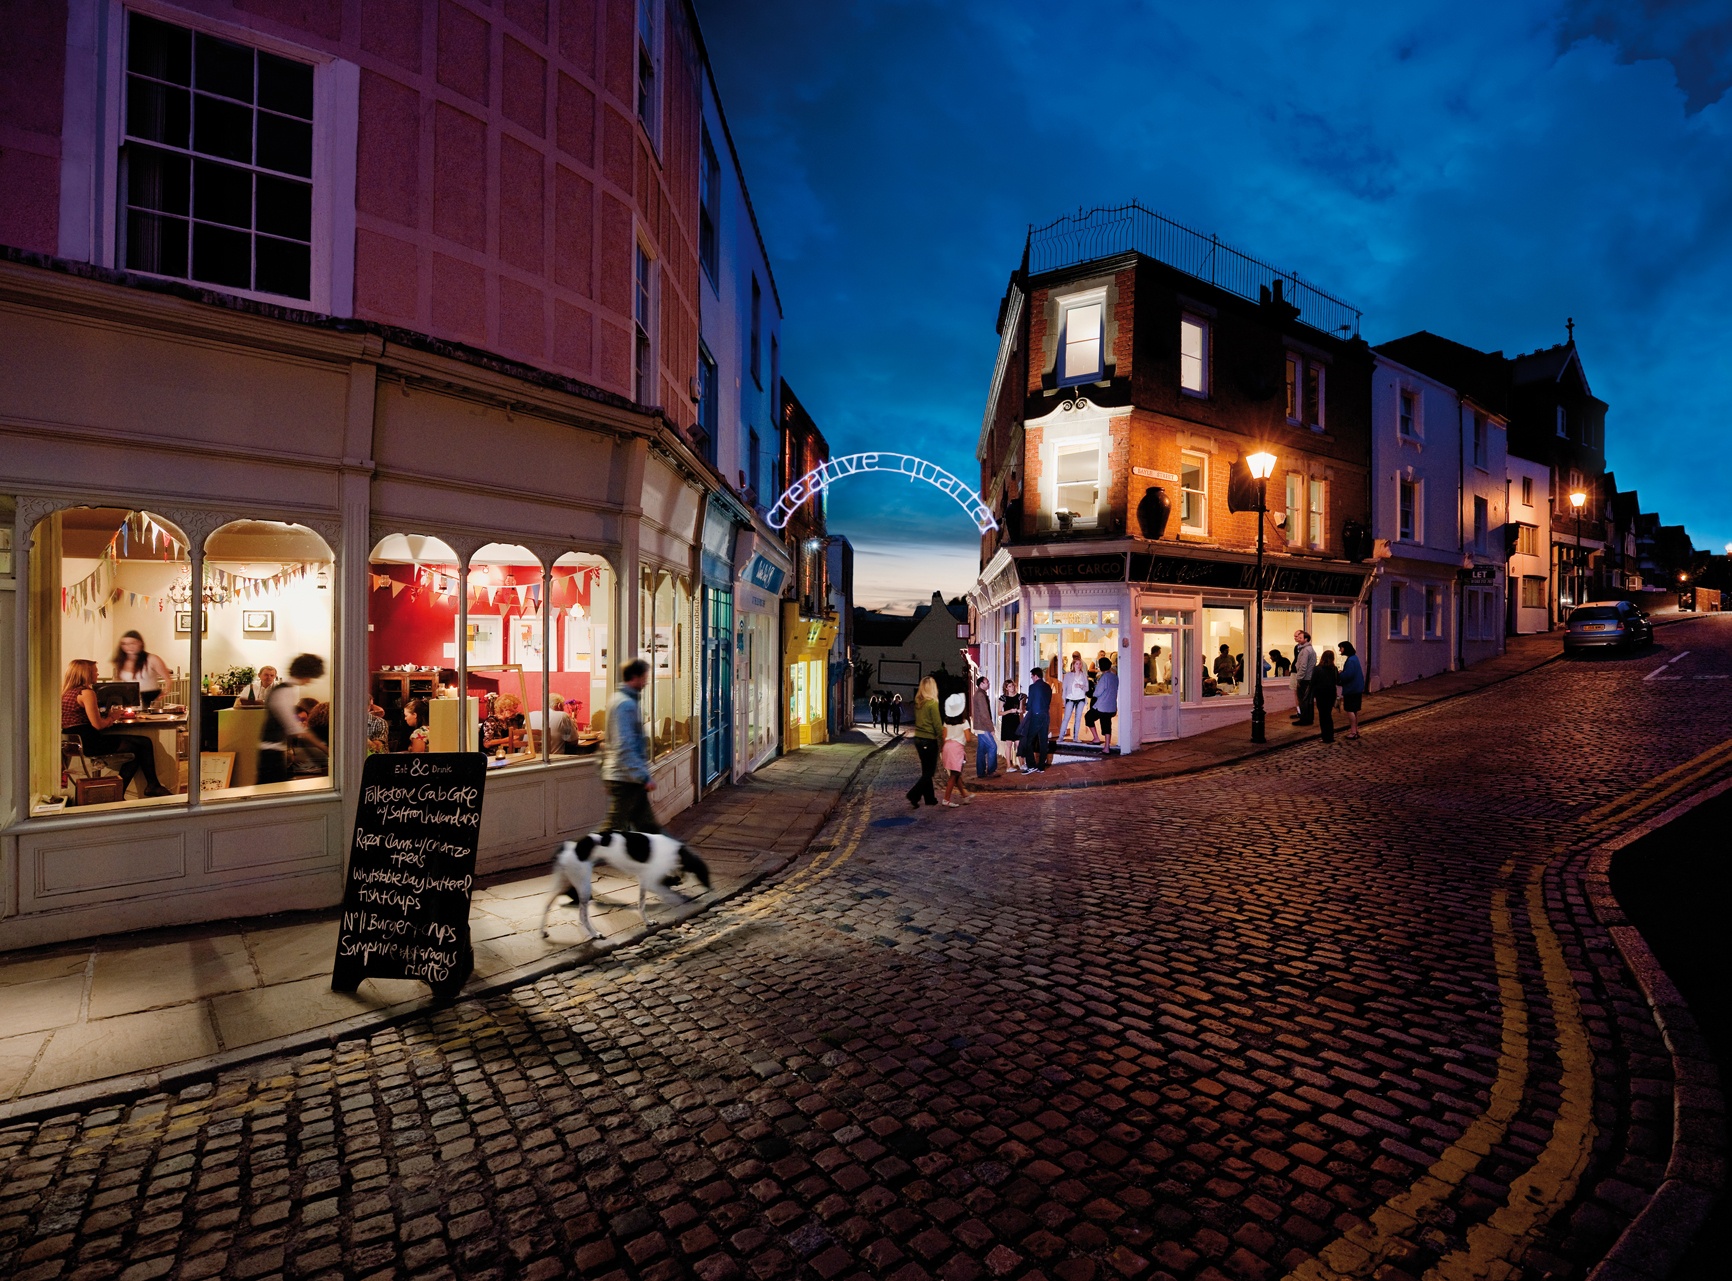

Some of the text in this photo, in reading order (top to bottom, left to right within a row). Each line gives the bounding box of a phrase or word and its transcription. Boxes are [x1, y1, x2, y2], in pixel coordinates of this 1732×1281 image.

[1021, 561, 1121, 577] STRANGE CARGO
[1305, 571, 1353, 595] SMITH
[394, 757, 452, 777] Eat & Drink
[364, 785, 417, 805] Folkestone
[355, 827, 386, 851] Razor
[367, 913, 412, 939] Burger
[405, 961, 449, 982] risotto
